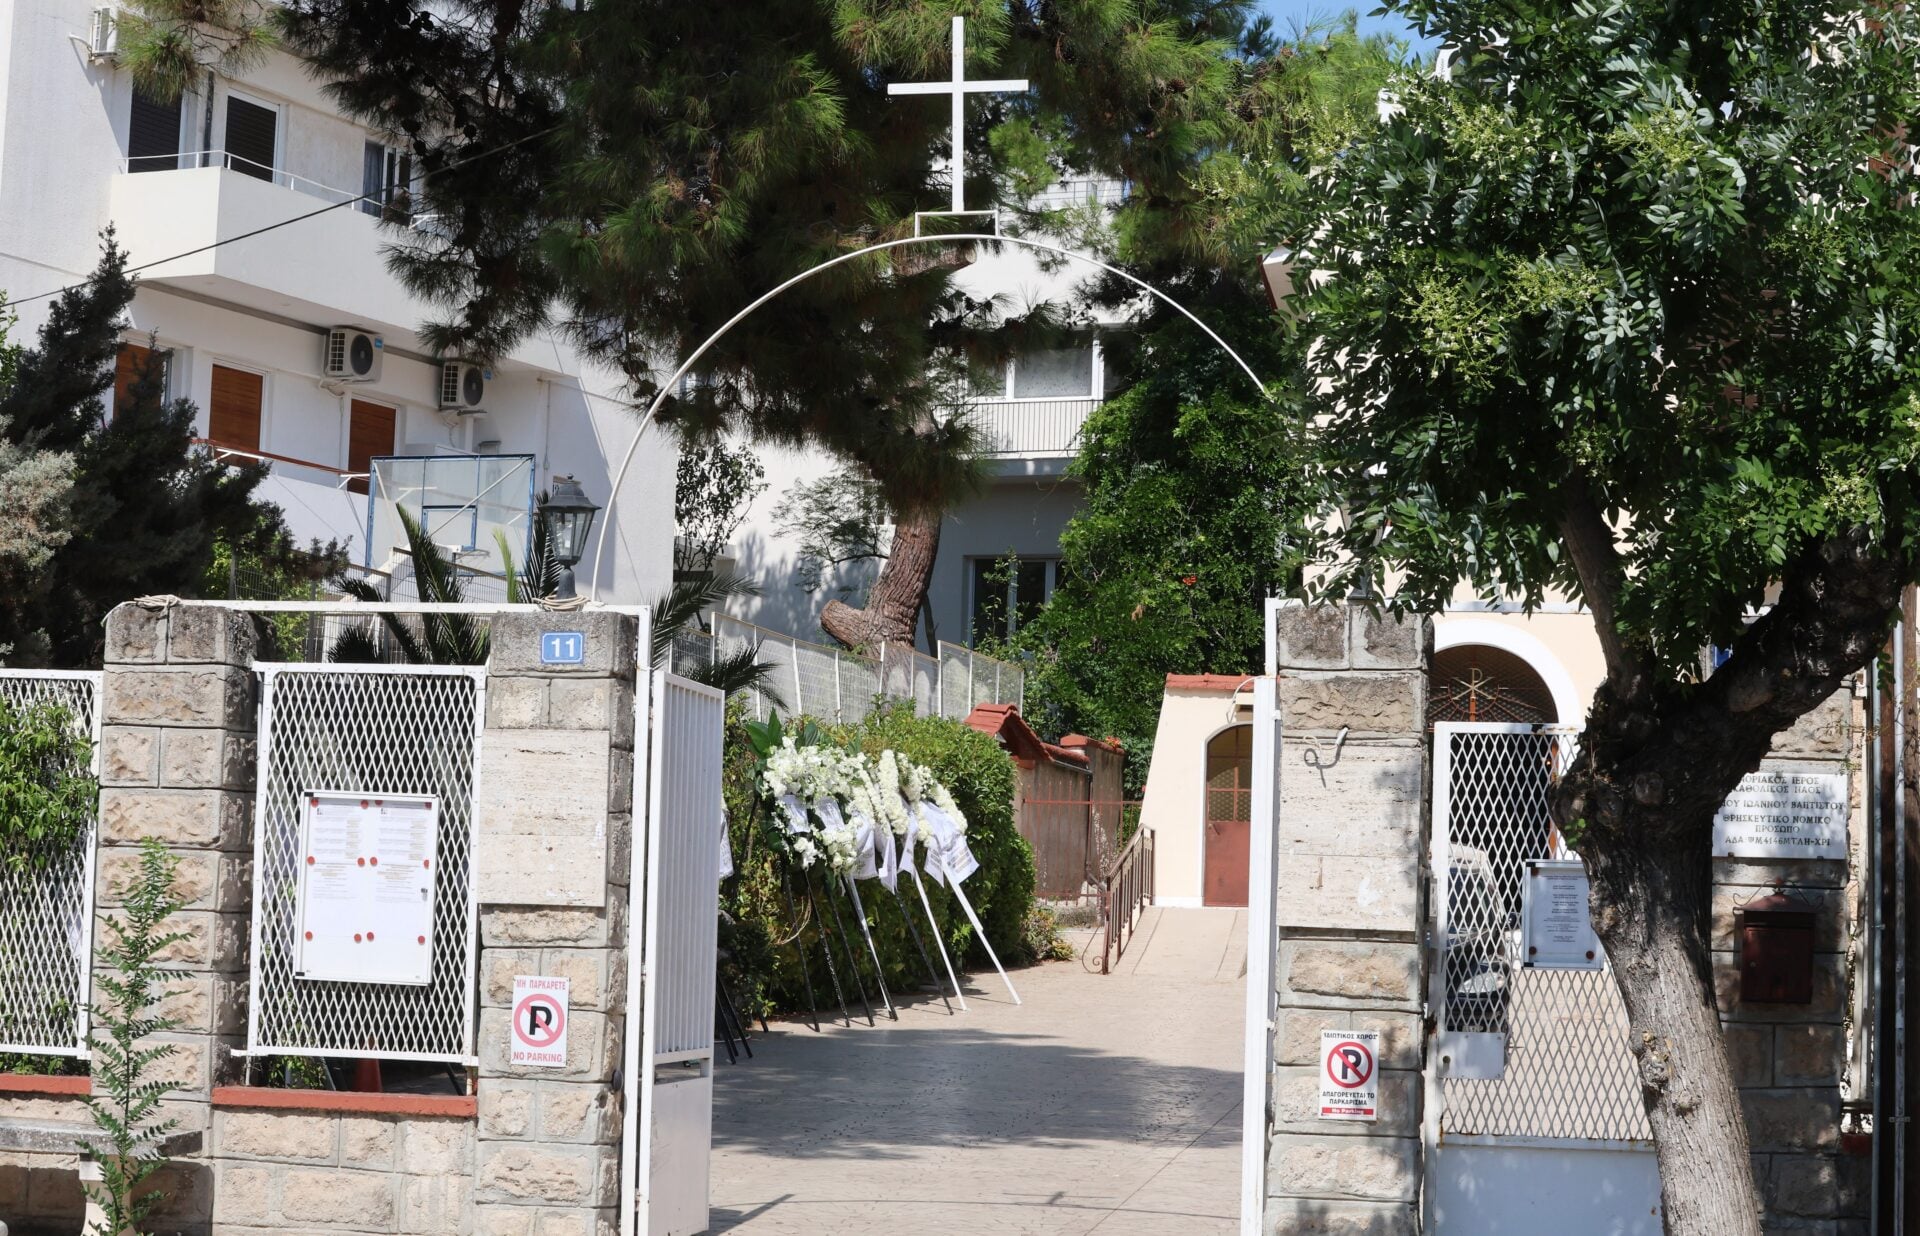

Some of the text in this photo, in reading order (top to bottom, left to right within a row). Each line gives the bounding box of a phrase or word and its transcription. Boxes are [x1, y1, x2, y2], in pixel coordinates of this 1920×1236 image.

[551, 637, 574, 658] 11
[1740, 775, 1819, 785] ΟΡΙΑΚΟΣ ΙΕΡΟΣ
[1743, 800, 1787, 809] ΙΩΑΝΝΟΥ
[1791, 801, 1845, 810] ΒΑΠΤΙΣΤΟΥ
[1722, 814, 1831, 825] ΘΡΗΣΚΕΥΤΙΚΟ ΝΟΜΙΚΟ
[1755, 824, 1800, 833] ΠΡΟΣΩΠΟ
[516, 979, 566, 990] ΜΗ ΠΑΡΚΑΡΕΤΕ
[513, 1051, 563, 1063] NO PARKING
[1322, 1090, 1366, 1098] ΑΠΑΓΟΡΕΥΕΤΑΙ
[1329, 1098, 1367, 1106] ΠΑΡΚΑΡΙΣΜΑ
